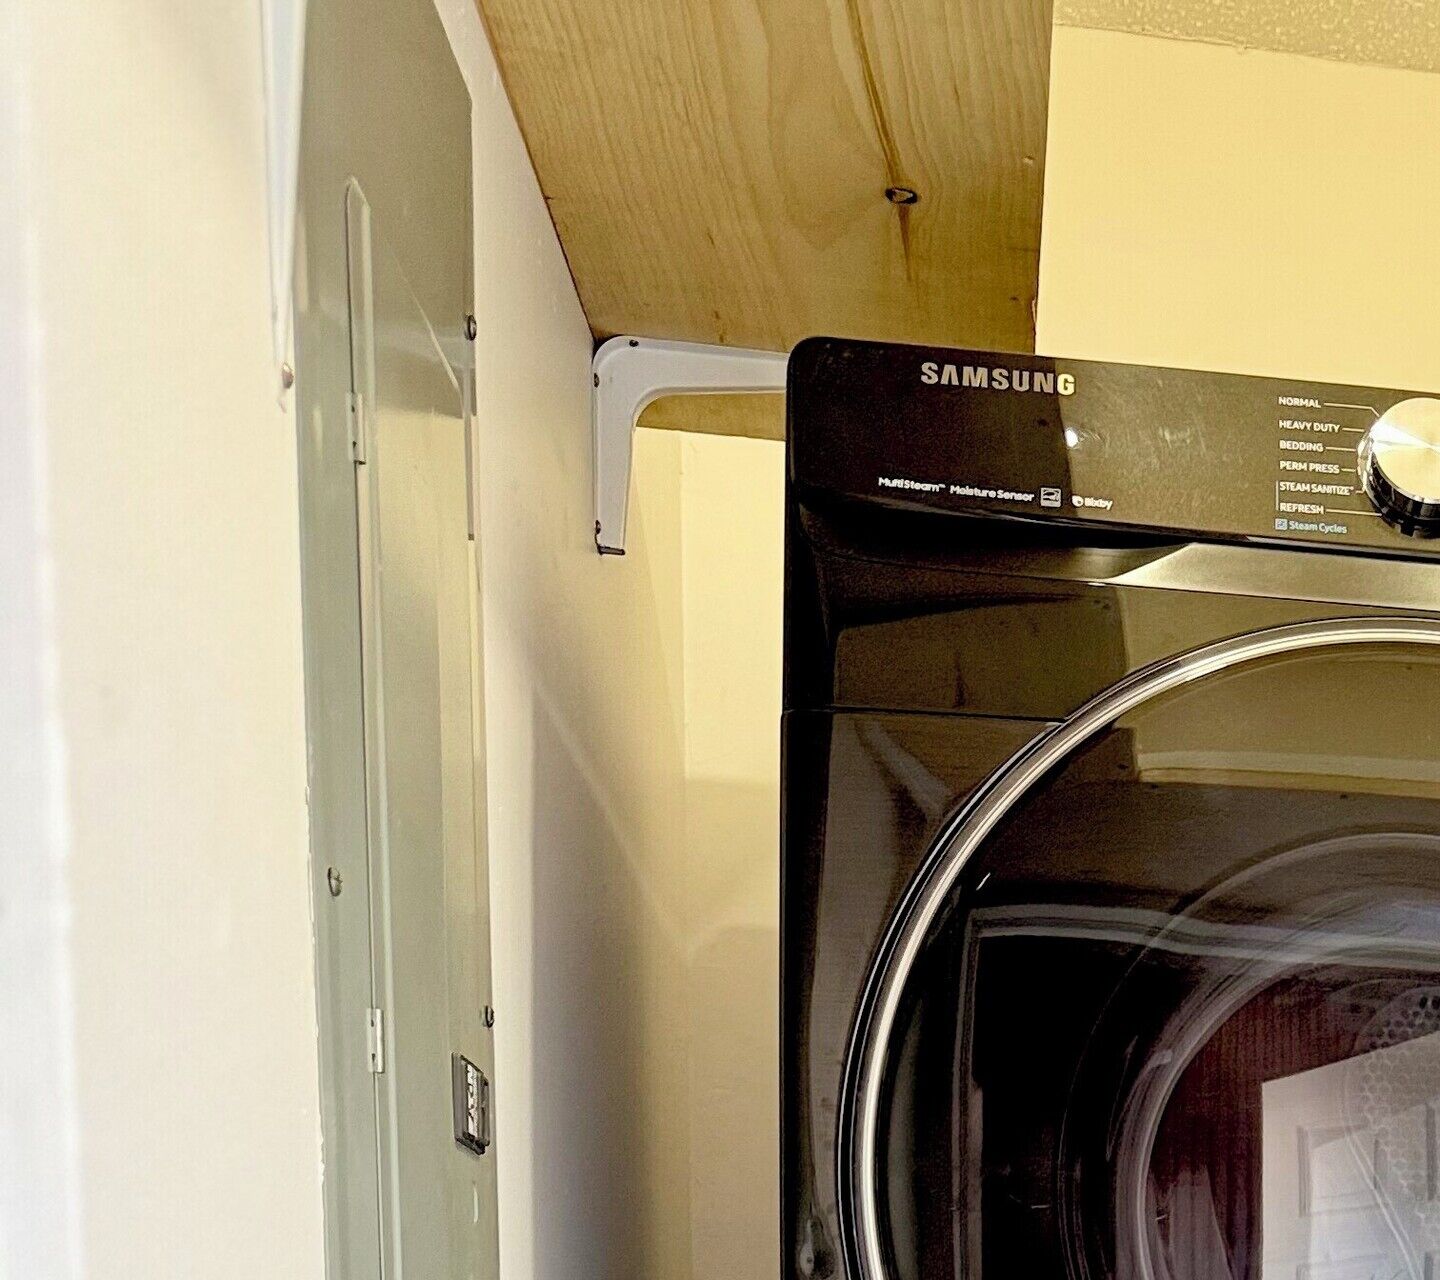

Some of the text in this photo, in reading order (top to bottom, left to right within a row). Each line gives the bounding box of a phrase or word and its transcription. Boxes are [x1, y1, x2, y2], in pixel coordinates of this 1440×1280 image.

[921, 362, 1075, 395] SAMSUNG
[1278, 397, 1321, 408] NORMAL
[1279, 420, 1340, 433] HEAVY DUTY
[1279, 440, 1324, 452] BEDDING
[1279, 461, 1340, 474] PERM PRESS
[1280, 482, 1310, 493] STEAM
[997, 489, 1034, 502] Sensor
[1279, 502, 1324, 515] REFRESH
[1288, 520, 1348, 534] Steam Cycles
